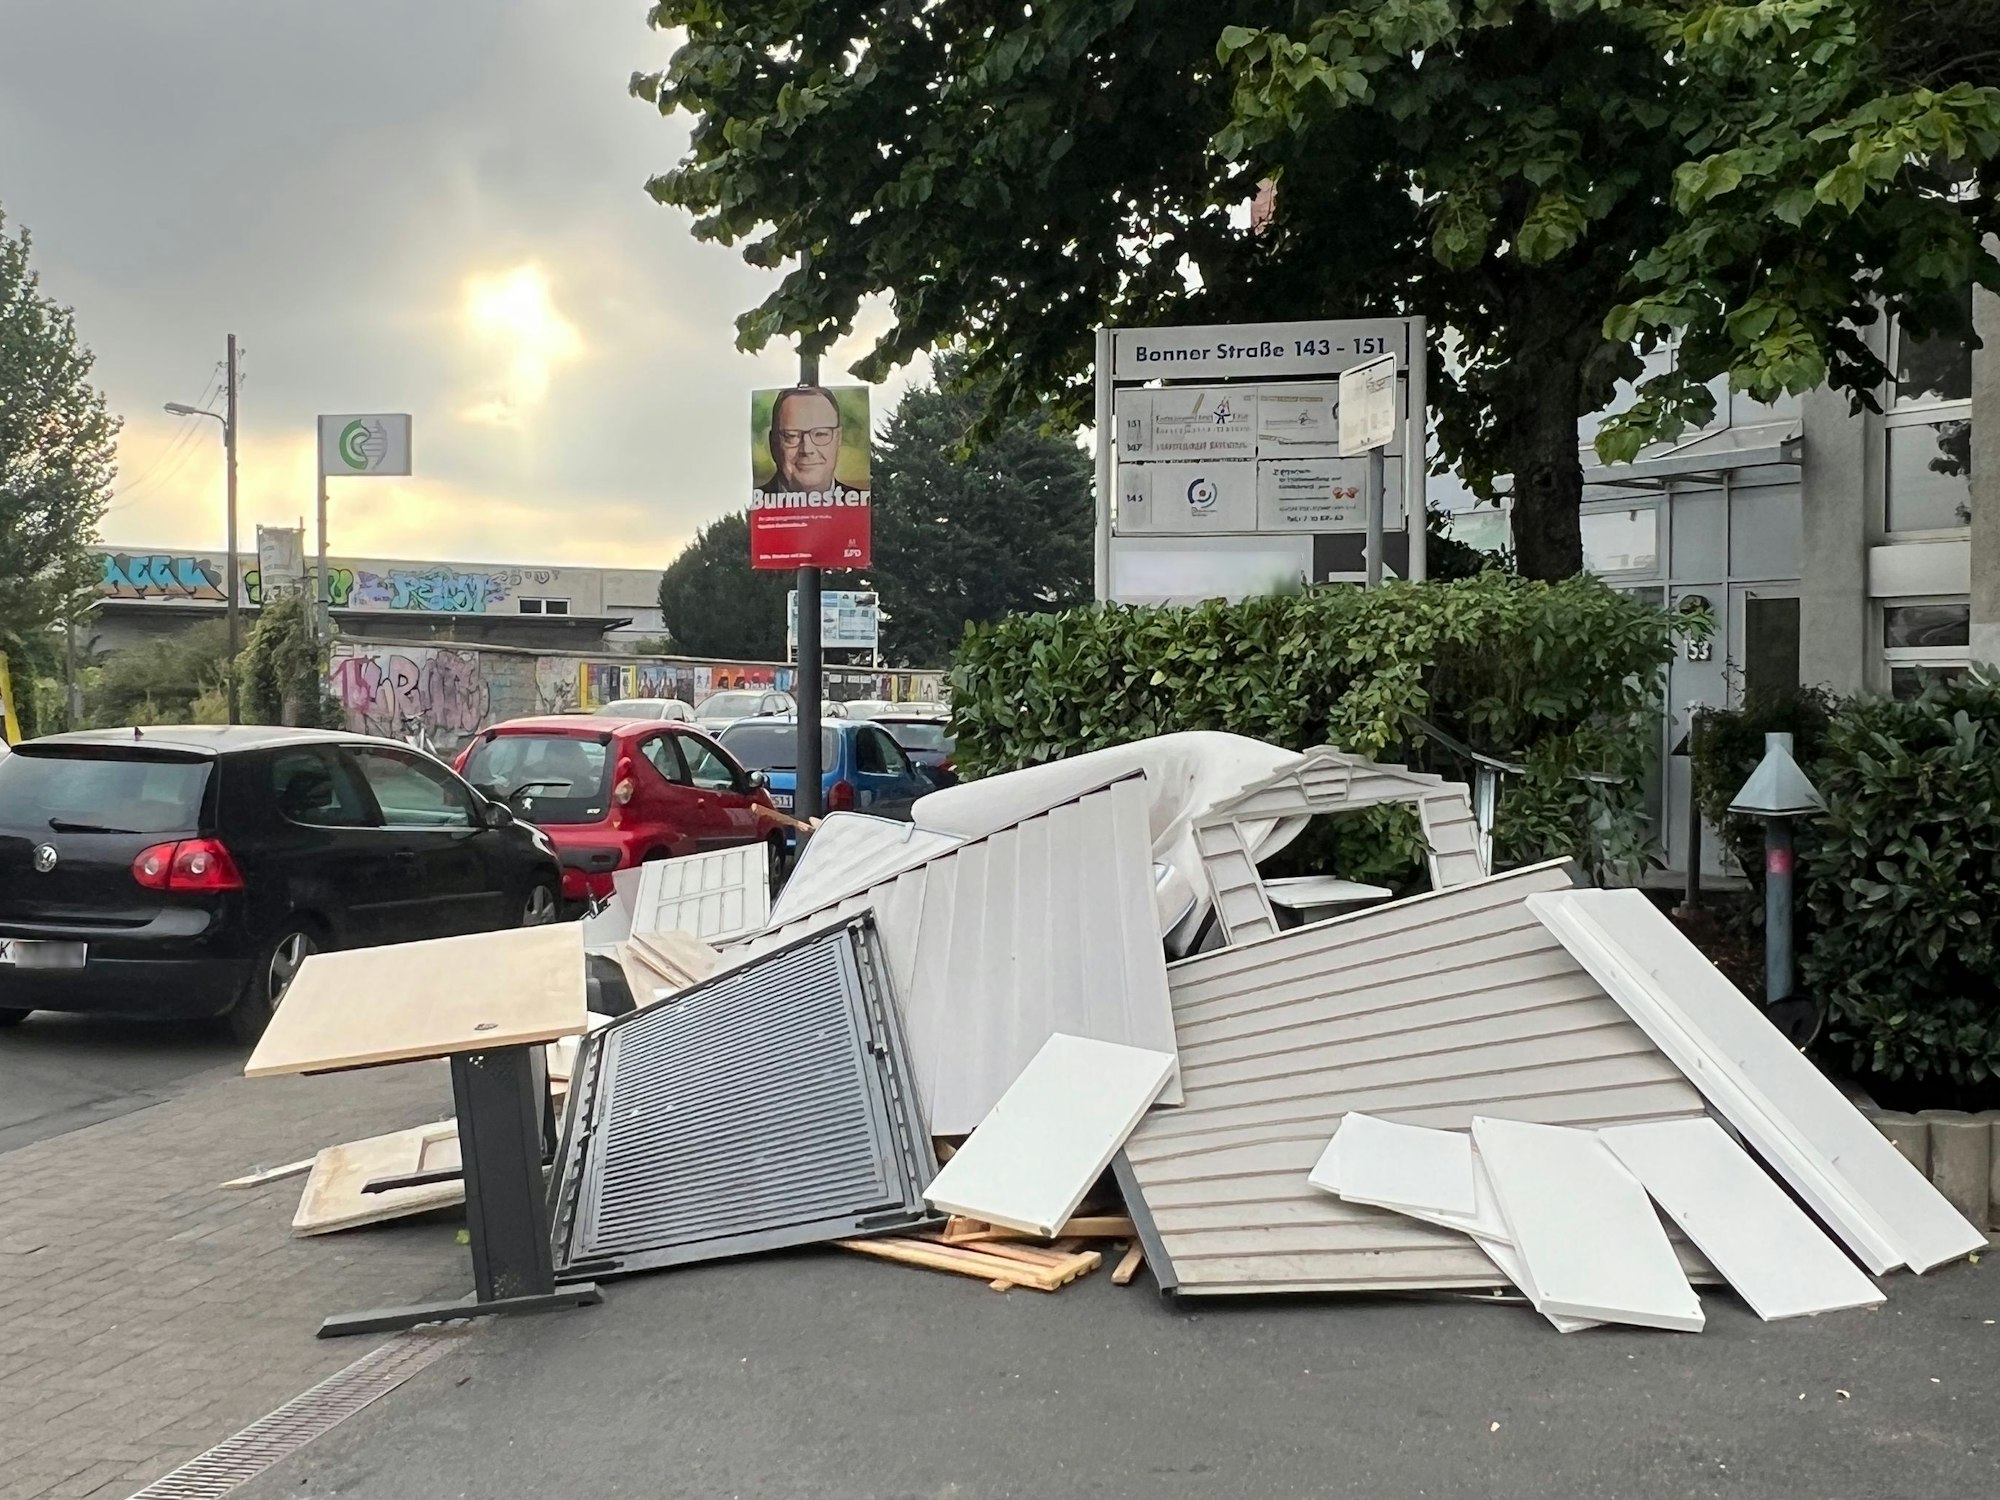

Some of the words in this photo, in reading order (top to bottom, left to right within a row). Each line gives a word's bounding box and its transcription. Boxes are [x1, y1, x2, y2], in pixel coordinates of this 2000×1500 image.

[1136, 346, 1211, 362] Bonner
[1217, 341, 1284, 359] Straße
[1294, 339, 1330, 357] 143
[1353, 337, 1385, 354] 151
[752, 486, 871, 509] Burmester
